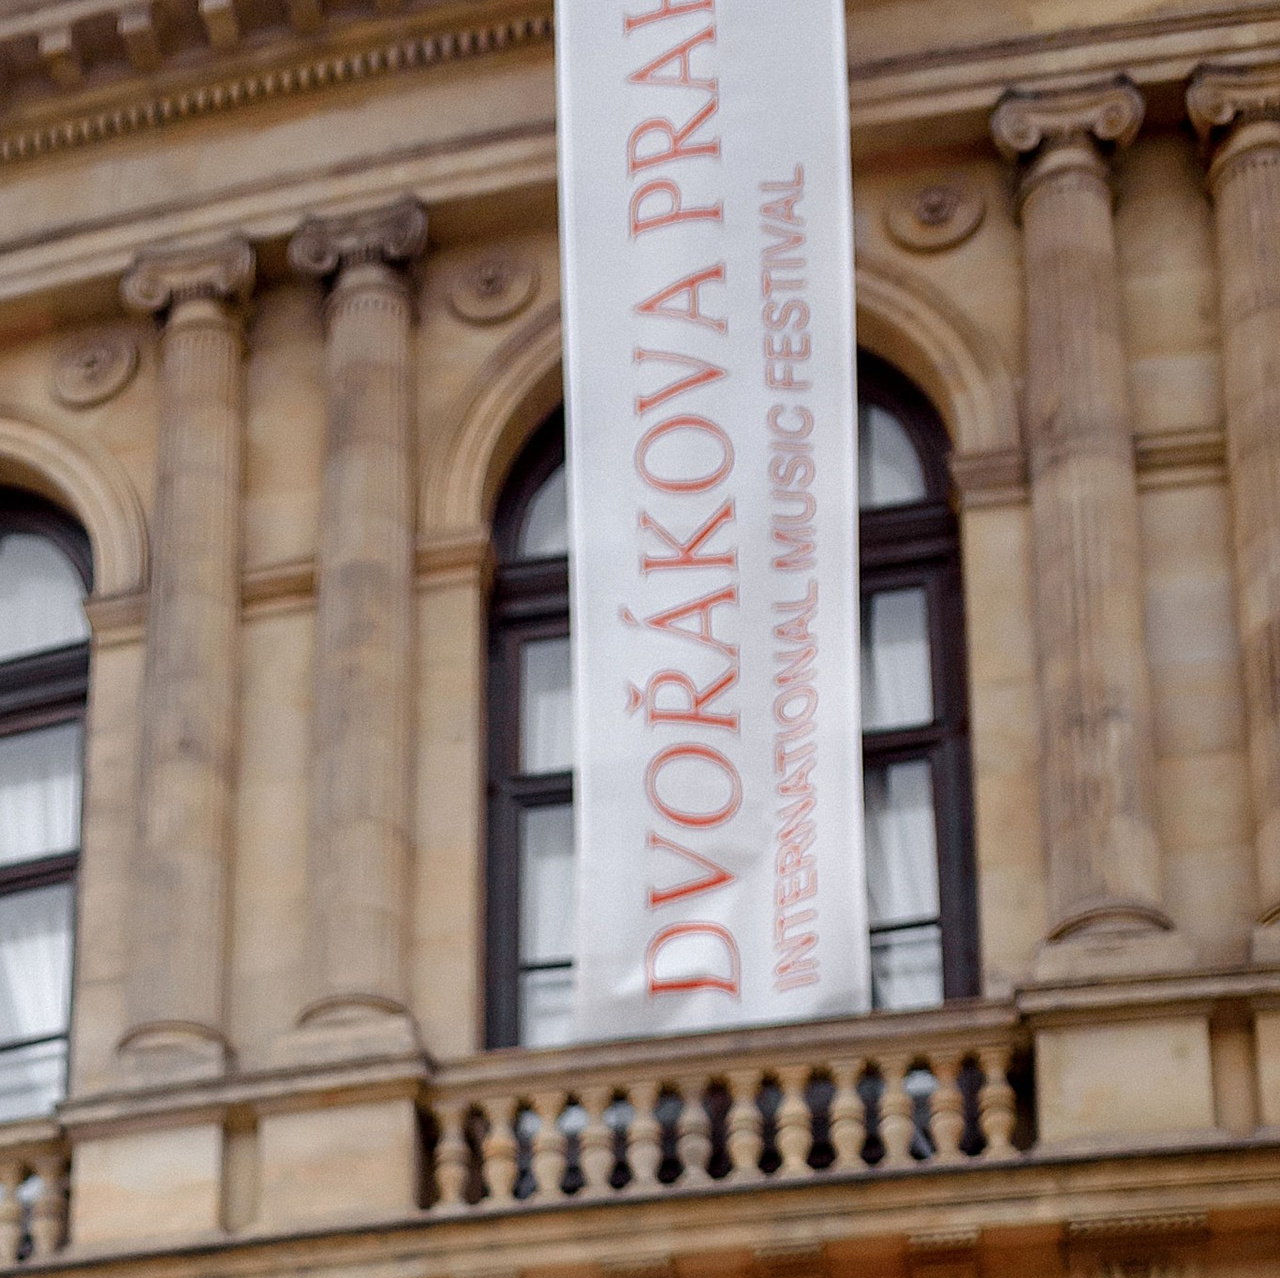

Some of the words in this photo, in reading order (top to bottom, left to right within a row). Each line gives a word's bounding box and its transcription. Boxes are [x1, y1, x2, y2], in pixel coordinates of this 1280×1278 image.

[760, 164, 812, 391] FESTIVAL
[620, 262, 742, 1000] DVOŘÁKOVA
[767, 404, 817, 570] MUSIC
[775, 579, 819, 992] INTERNATIONAL
